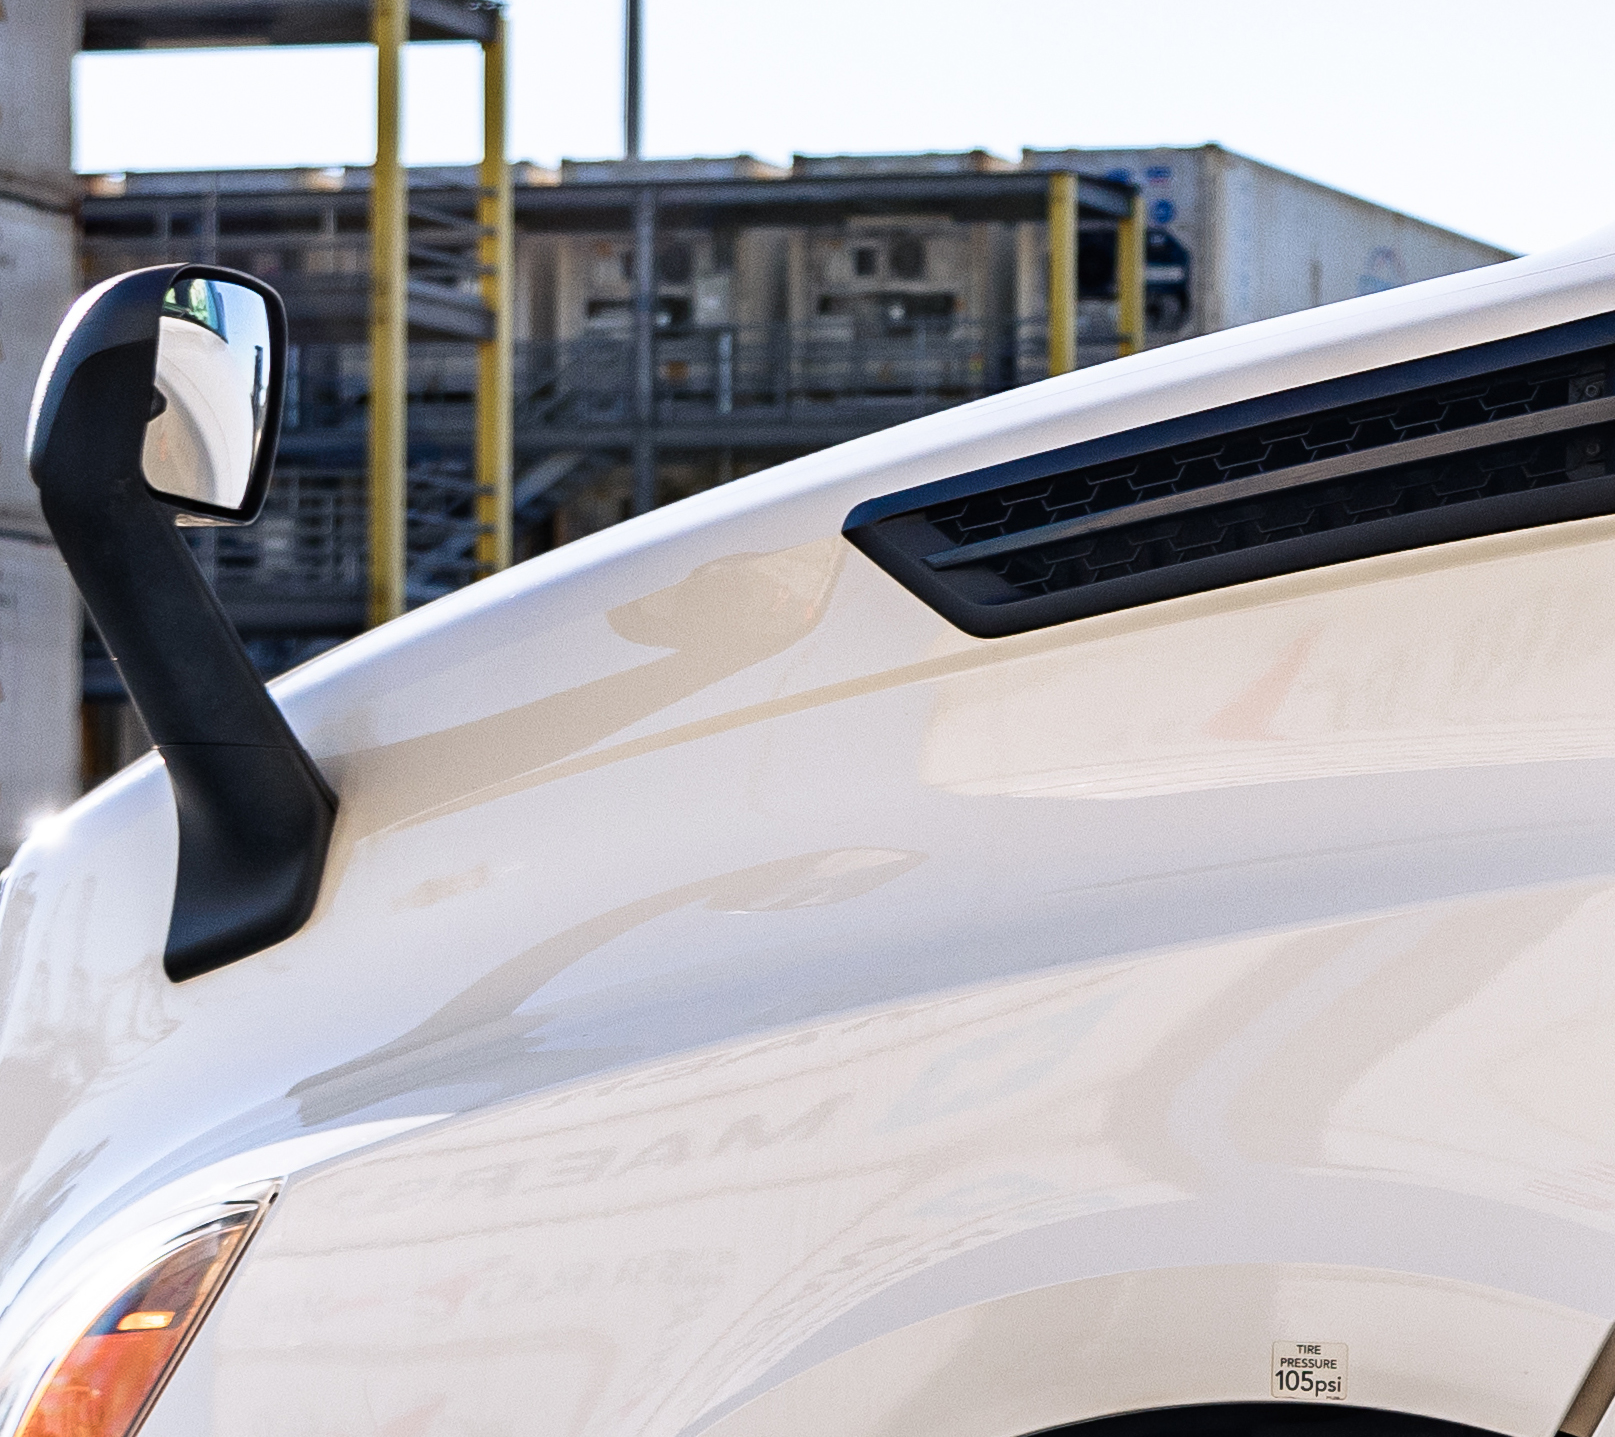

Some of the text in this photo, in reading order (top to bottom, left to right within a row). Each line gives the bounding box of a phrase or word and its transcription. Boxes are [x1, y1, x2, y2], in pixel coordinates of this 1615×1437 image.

[1296, 1344, 1321, 1355] TIRE
[1280, 1357, 1337, 1369] PRESSURE
[1275, 1370, 1342, 1397] 105psi
